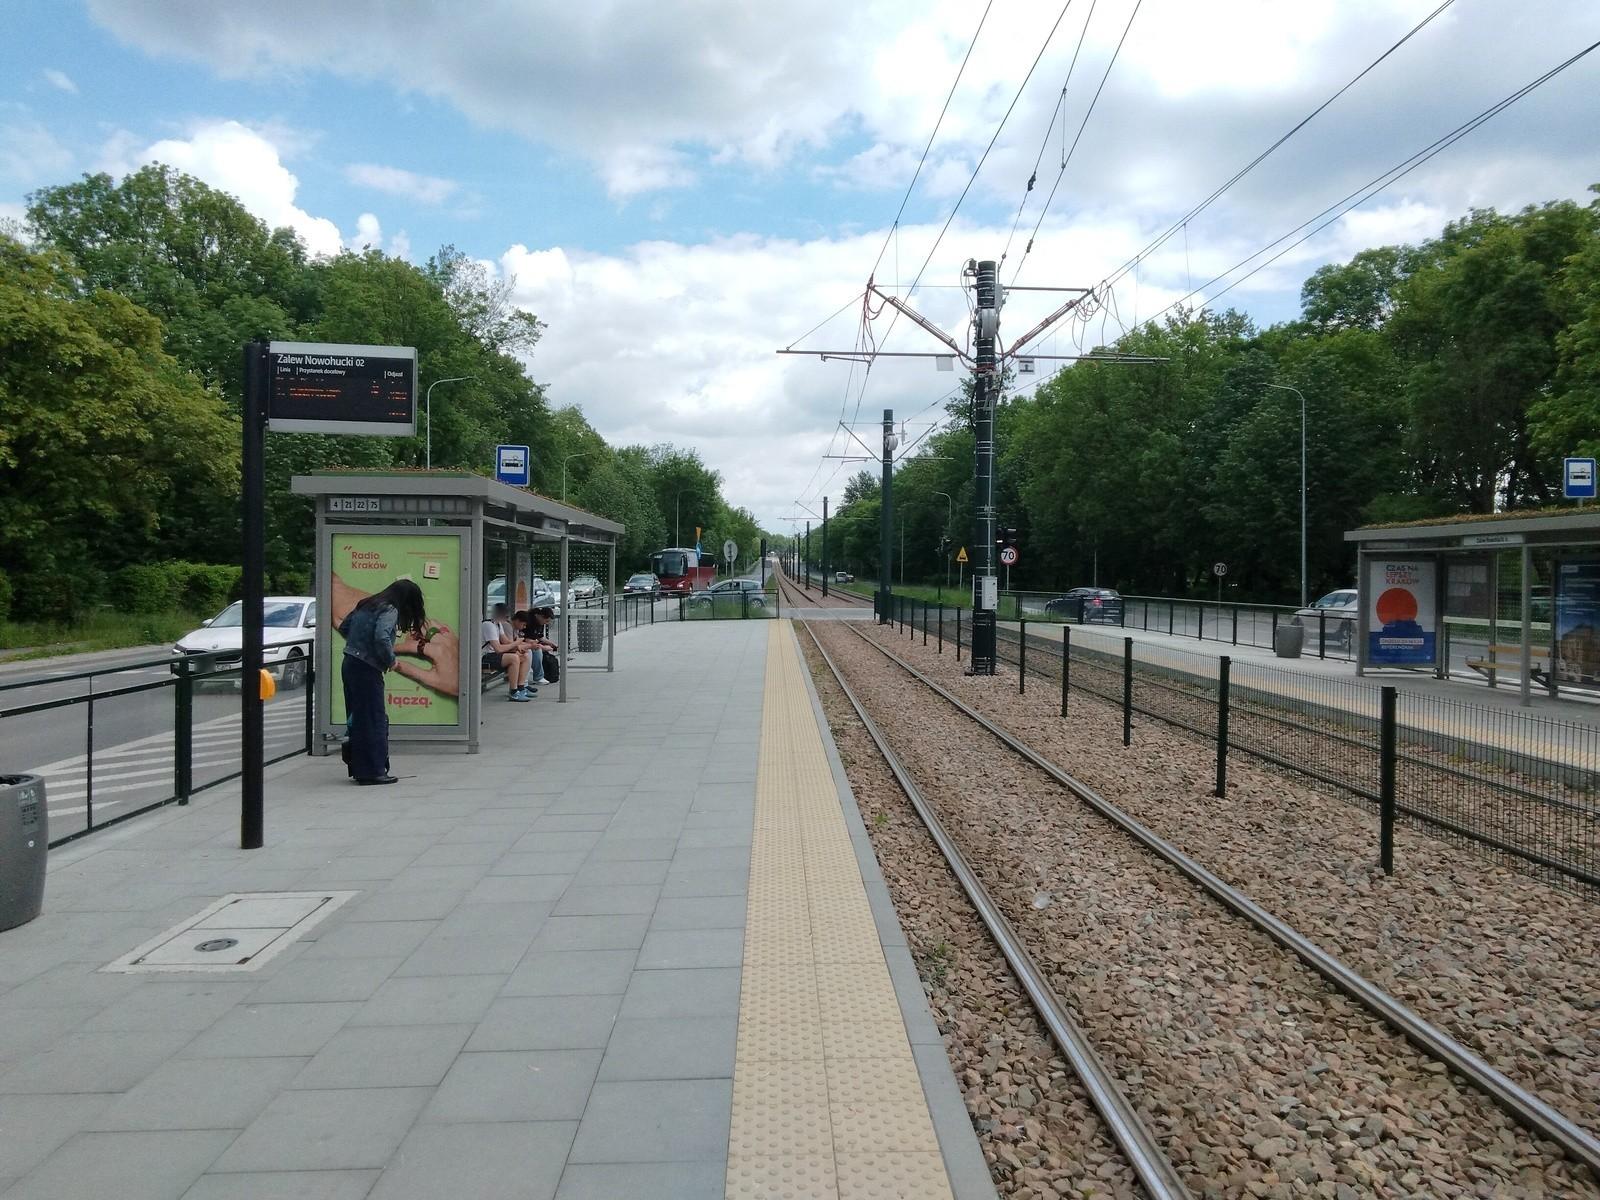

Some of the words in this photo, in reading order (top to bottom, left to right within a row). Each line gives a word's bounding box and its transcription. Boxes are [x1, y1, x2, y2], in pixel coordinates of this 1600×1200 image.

[277, 354, 303, 365] Zalew
[304, 355, 354, 367] Nowohucki
[355, 359, 365, 367] 02
[299, 367, 323, 375] Przystanek
[344, 501, 352, 509] 21
[357, 501, 365, 509] 22
[351, 551, 380, 560] Radio
[1002, 551, 1015, 560] 70
[351, 561, 388, 570] Kraków
[428, 565, 436, 575] E
[1215, 564, 1226, 573] 70
[388, 693, 433, 708] łączą.
